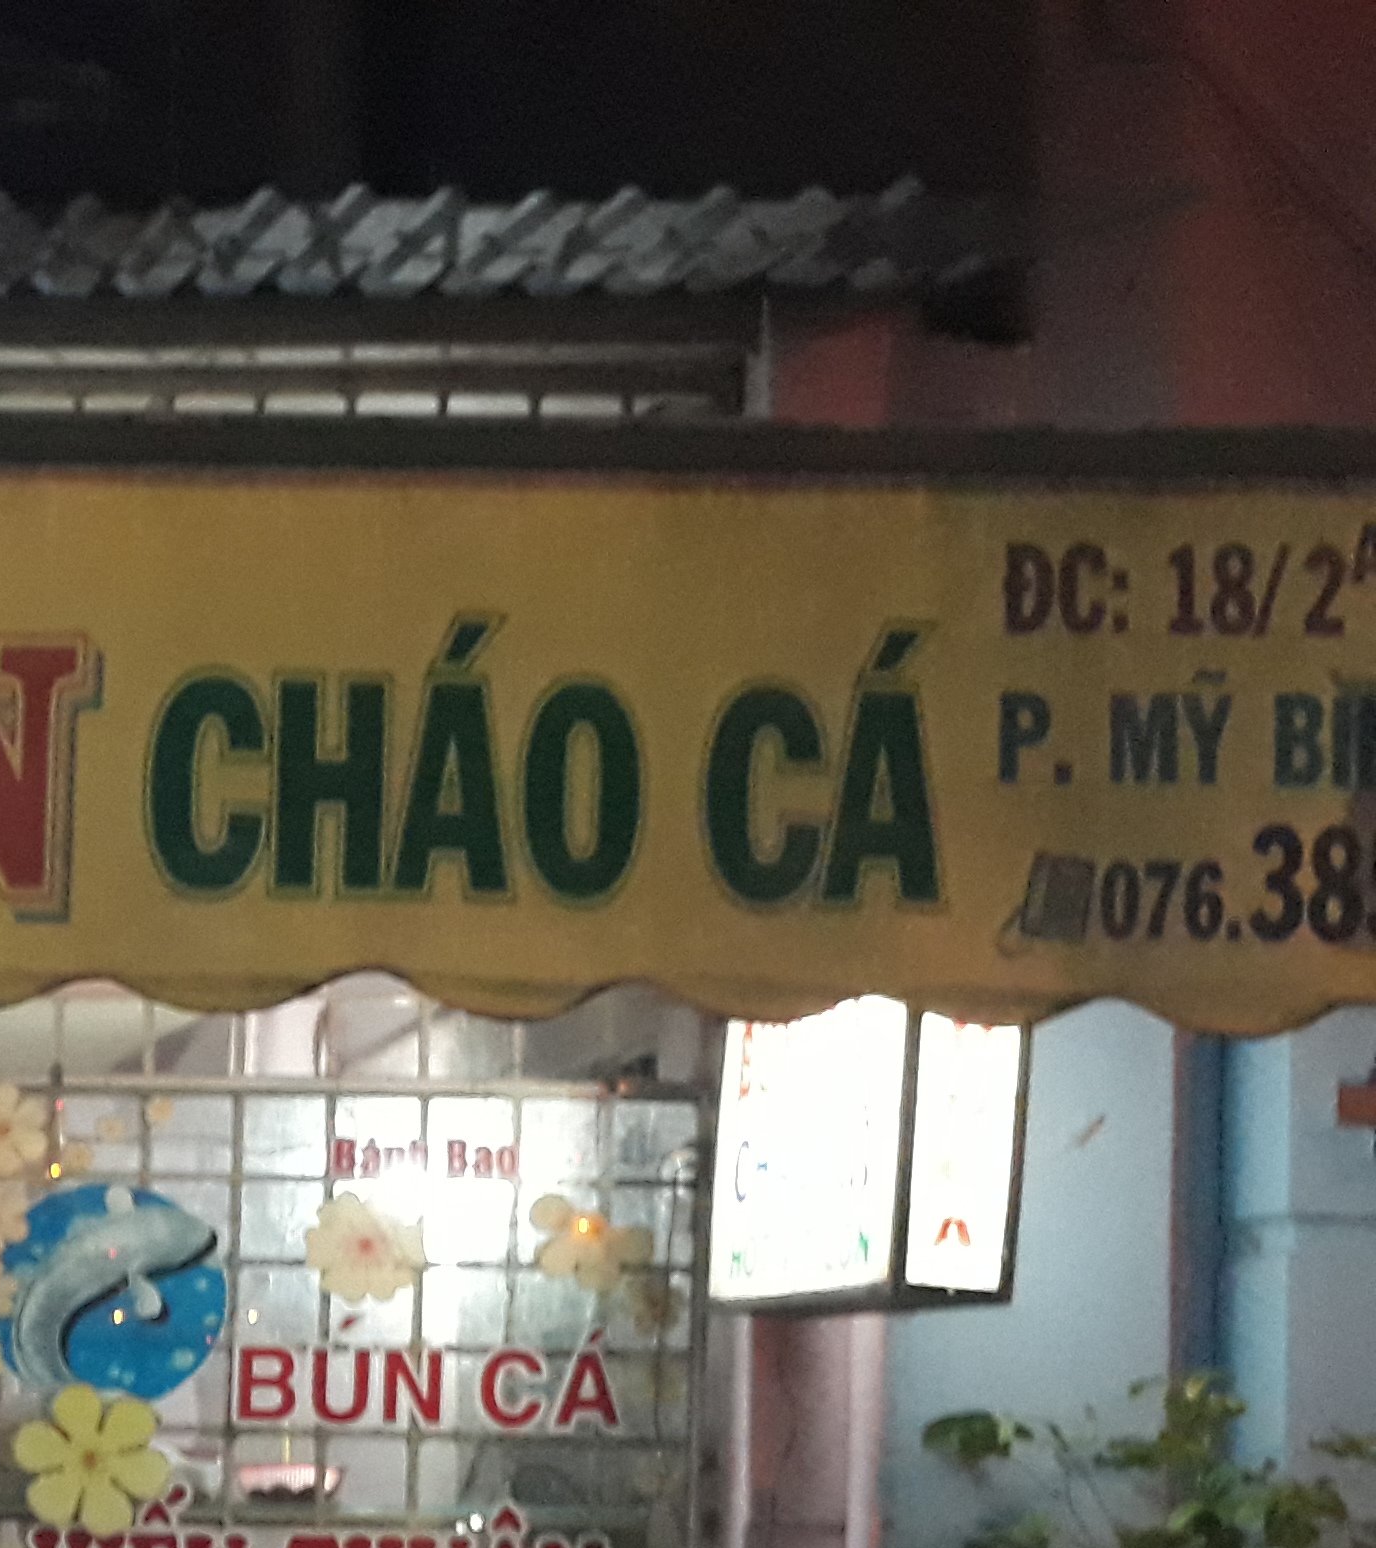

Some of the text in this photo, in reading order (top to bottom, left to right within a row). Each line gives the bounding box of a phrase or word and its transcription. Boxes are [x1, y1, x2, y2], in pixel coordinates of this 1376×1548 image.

[1003, 541, 1129, 636] ĐC:
[145, 612, 641, 902] CHÁO
[703, 617, 945, 908] CÁ
[998, 689, 1072, 786] P.
[235, 1313, 619, 1430] BÚN CÁ
